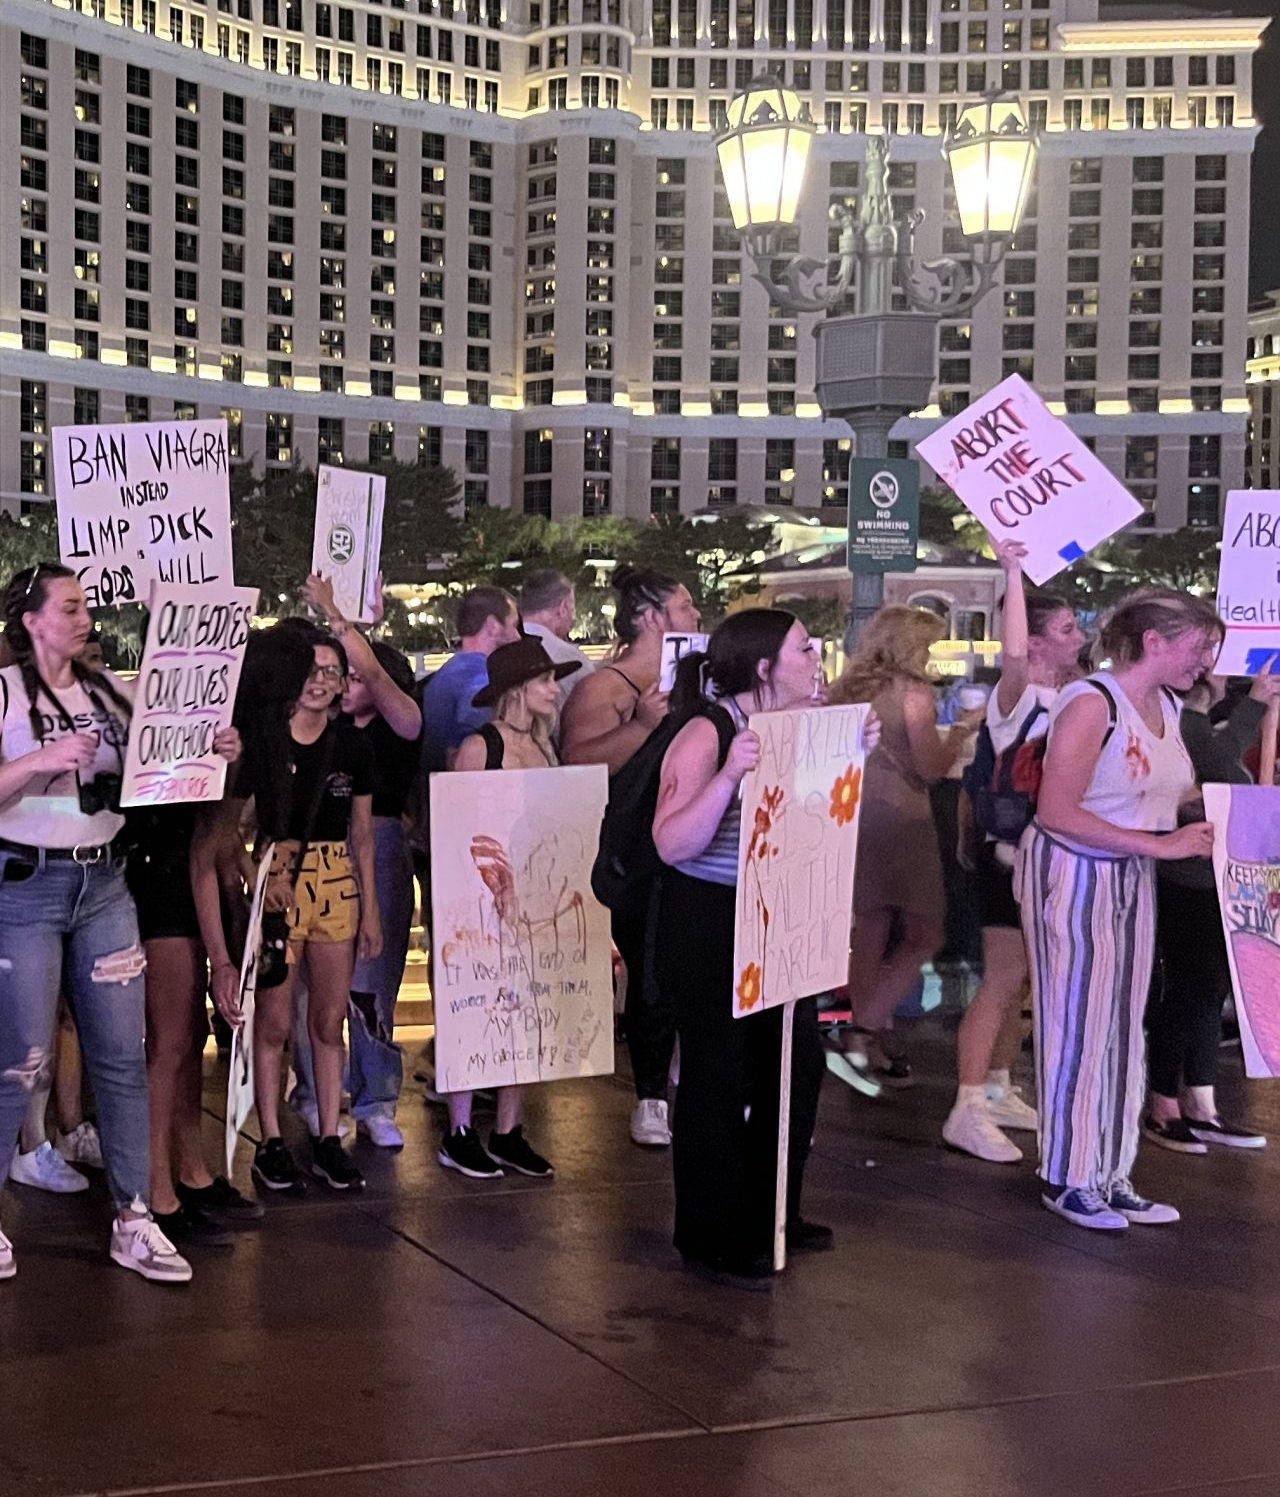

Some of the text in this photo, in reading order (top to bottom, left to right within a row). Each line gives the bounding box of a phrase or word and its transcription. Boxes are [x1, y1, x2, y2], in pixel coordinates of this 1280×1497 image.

[951, 397, 1028, 469] ABORT
[69, 427, 227, 488] BAN VIAGRA
[984, 440, 1041, 484] THE
[120, 480, 168, 509] INSTEAD
[990, 453, 1086, 528] COURT
[67, 506, 213, 558] LIMP DICK
[858, 520, 910, 530] SWIMMING
[877, 510, 891, 519] NO
[158, 552, 219, 585] WILL
